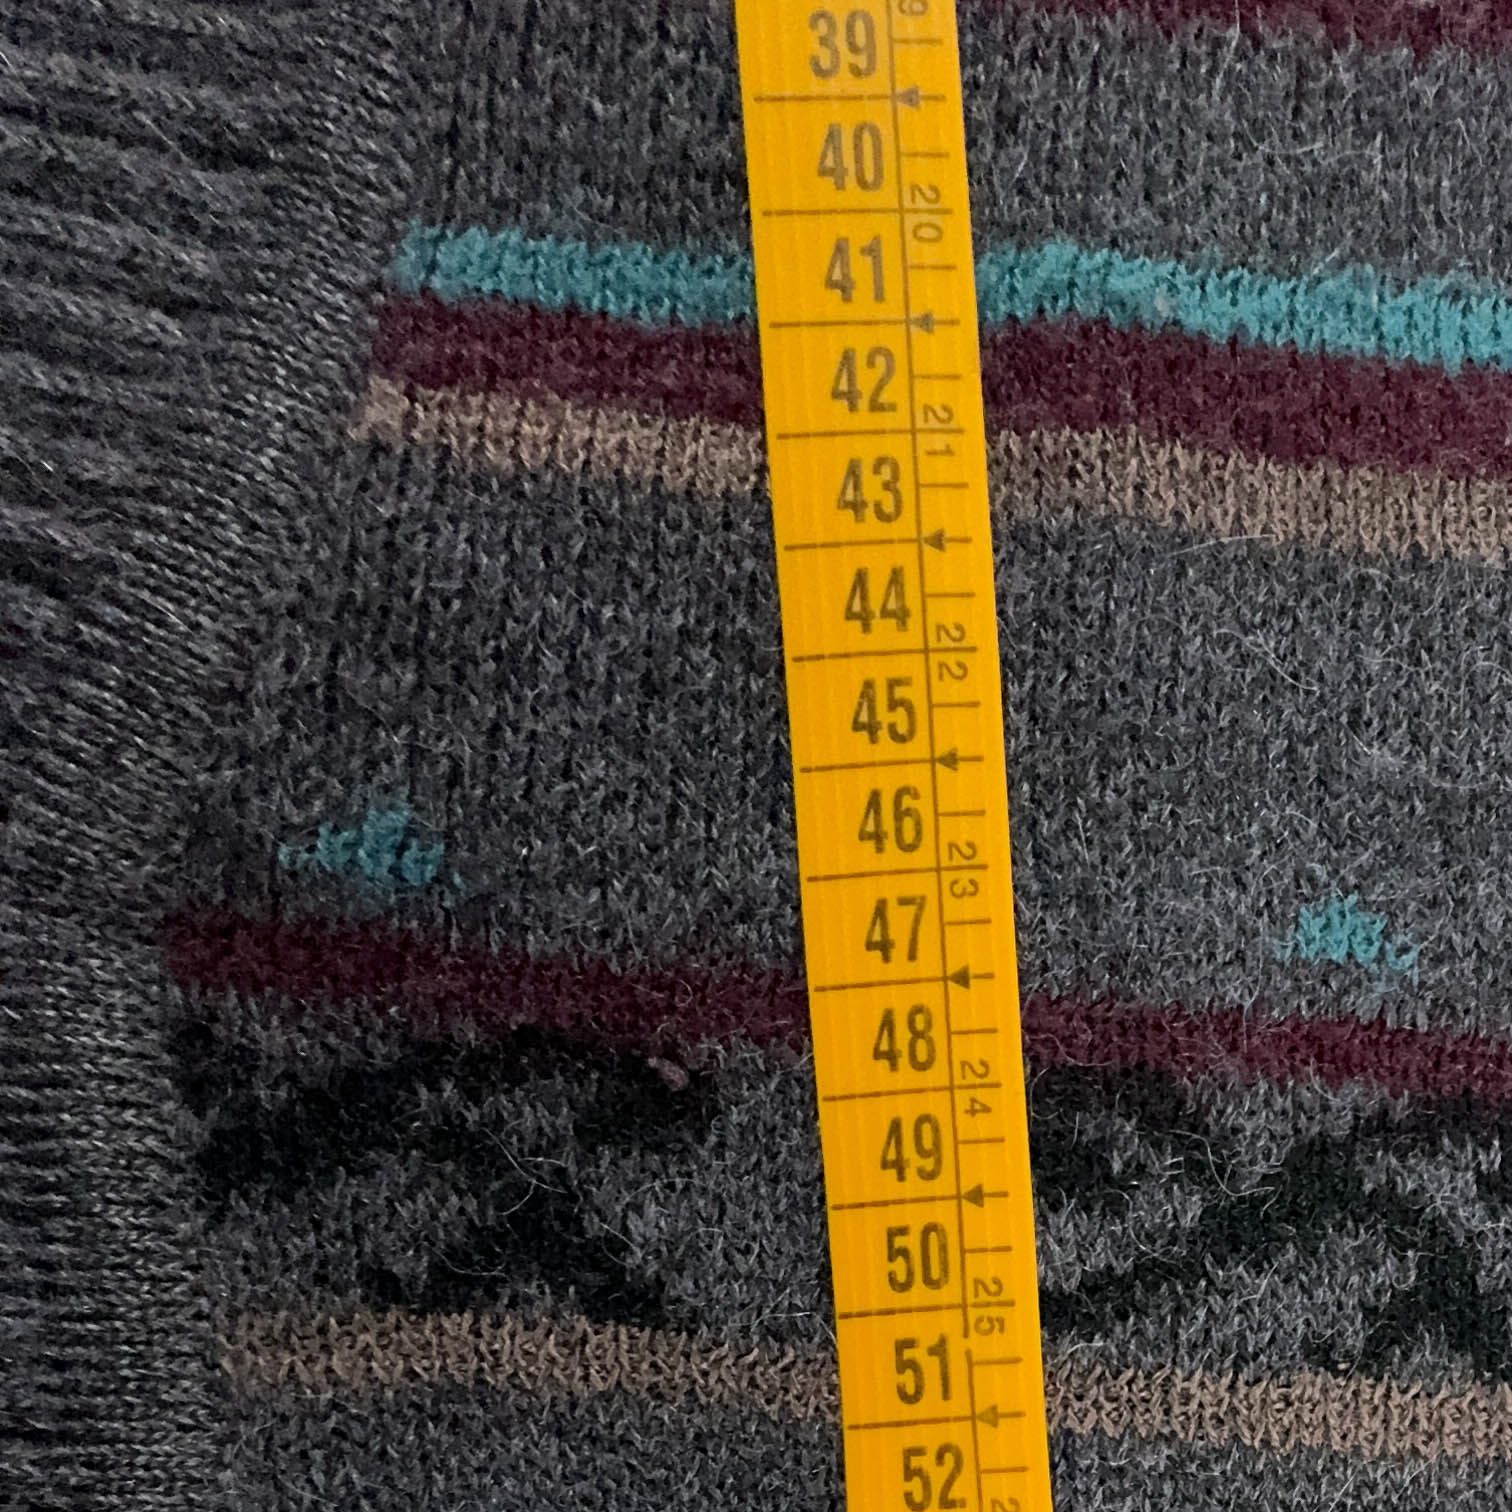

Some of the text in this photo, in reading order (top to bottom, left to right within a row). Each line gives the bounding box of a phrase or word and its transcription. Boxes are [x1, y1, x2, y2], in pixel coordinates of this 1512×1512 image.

[808, 7, 877, 81] 39
[816, 120, 884, 192] 40
[910, 184, 944, 243] 20
[824, 234, 886, 304] 41
[830, 345, 897, 414] 42
[923, 404, 955, 457] 21
[836, 454, 904, 524] 43
[843, 565, 912, 636] 44
[935, 622, 968, 681] 22
[850, 676, 917, 745] 45
[858, 784, 923, 855] 46
[947, 840, 979, 899] 23
[864, 894, 927, 965] 47
[872, 1003, 936, 1073] 48
[960, 1059, 992, 1118] 24
[880, 1113, 943, 1183] 49
[885, 1221, 950, 1294] 50
[973, 1277, 1005, 1336] 25
[894, 1333, 952, 1406] 51
